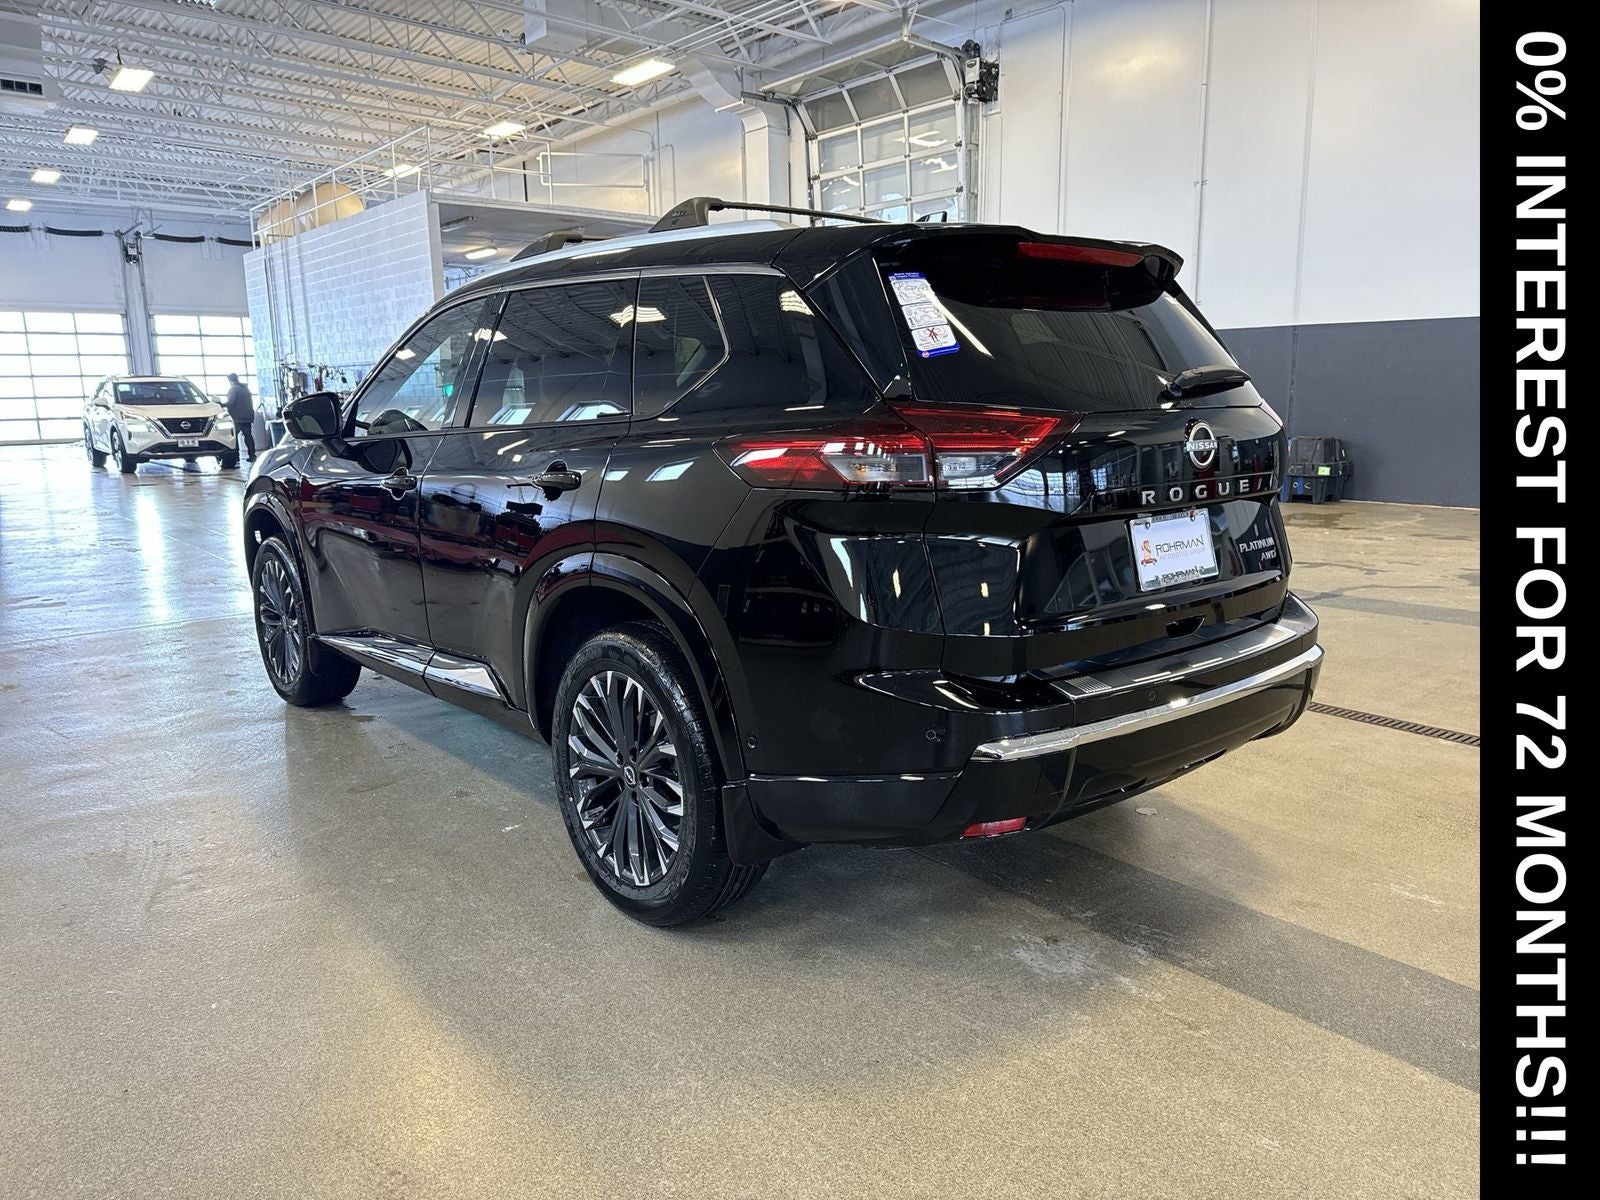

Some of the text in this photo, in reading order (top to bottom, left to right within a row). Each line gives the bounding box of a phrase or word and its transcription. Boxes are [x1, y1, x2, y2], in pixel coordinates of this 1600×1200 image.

[1186, 439, 1218, 451] NISSAN
[1141, 479, 1250, 505] ROGUE
[1155, 535, 1204, 556] ROHRMAN
[1239, 537, 1275, 553] PLATINUM
[1261, 549, 1277, 561] AWD
